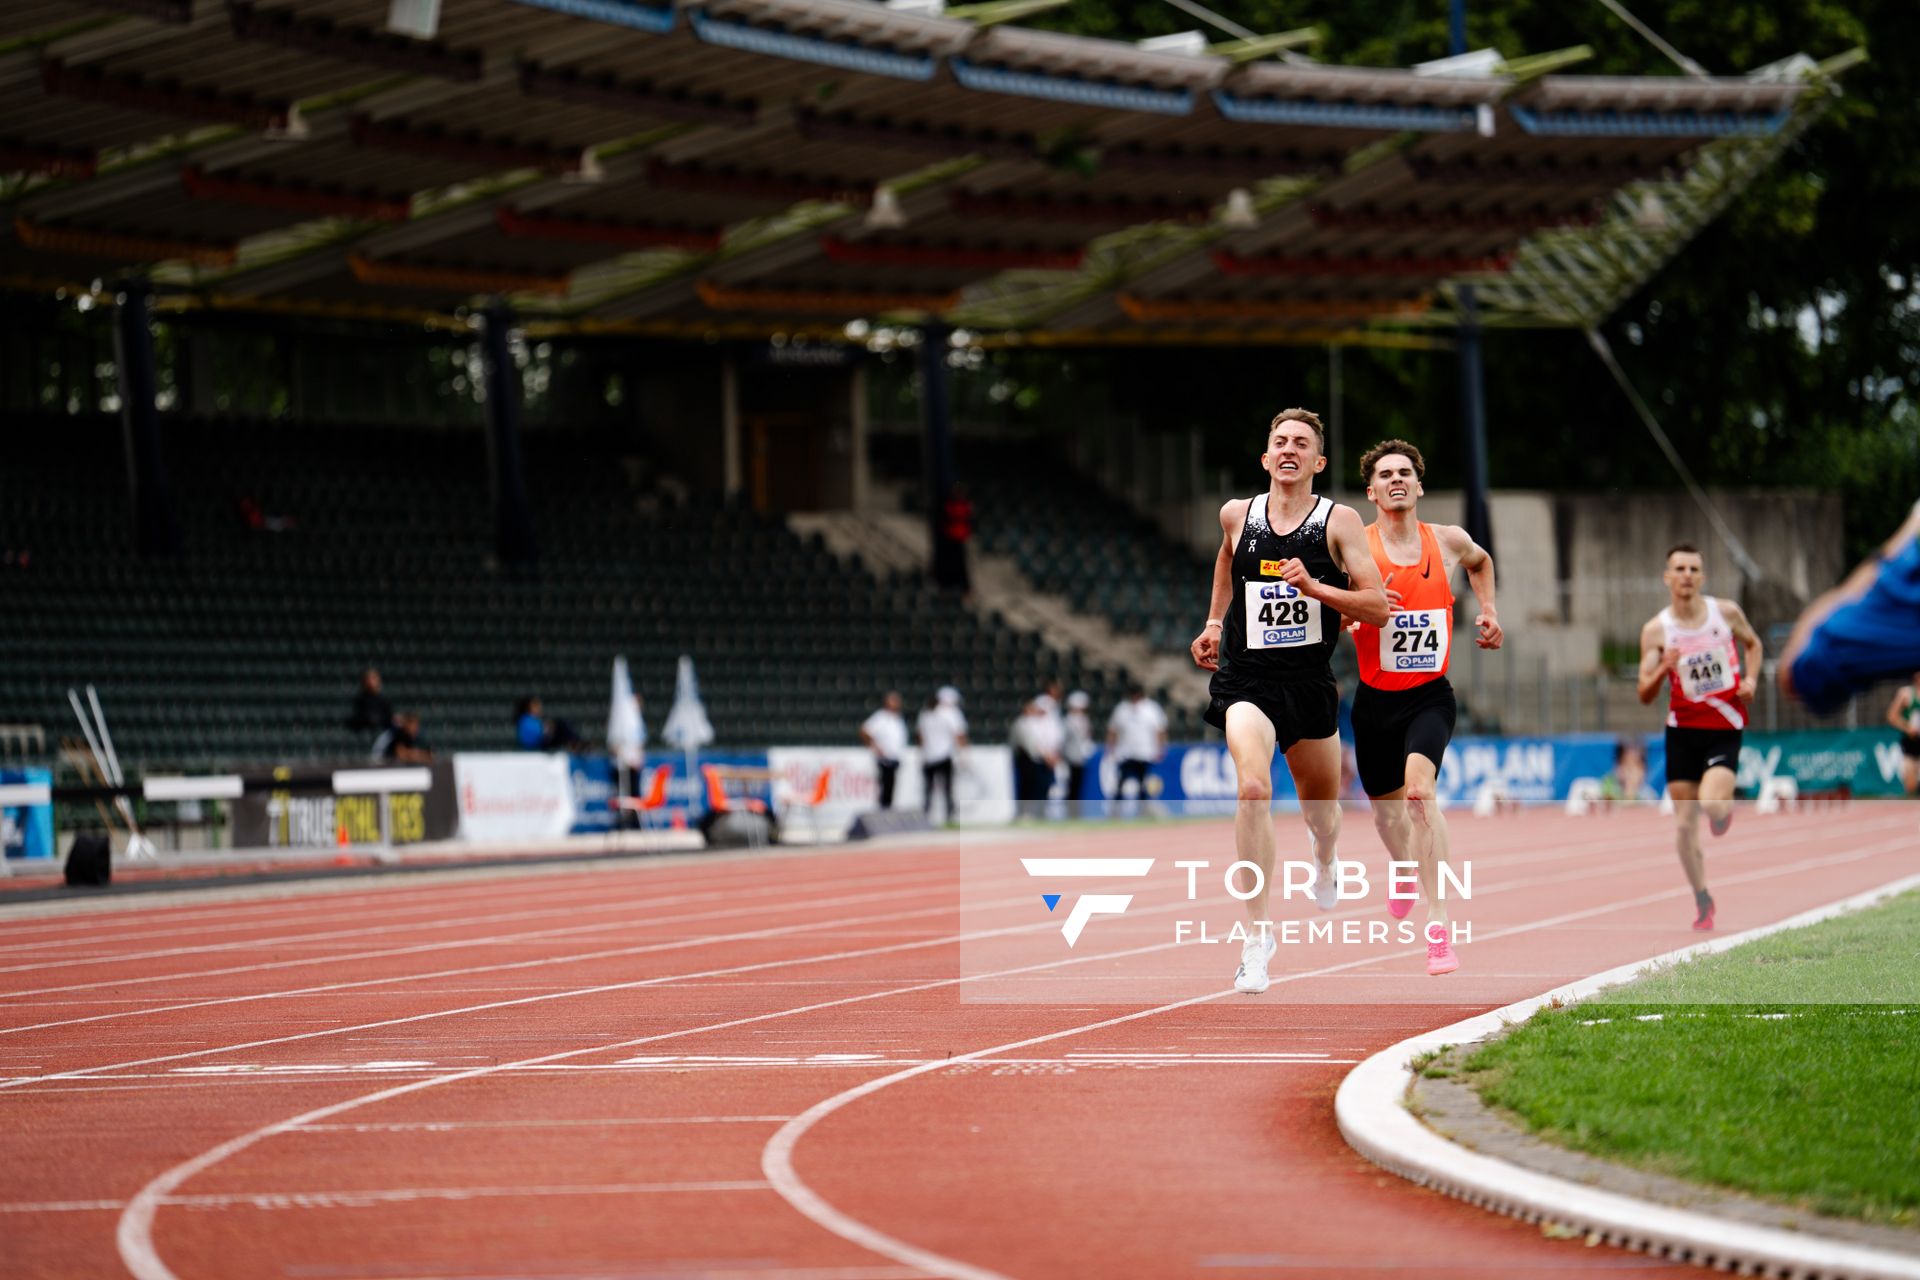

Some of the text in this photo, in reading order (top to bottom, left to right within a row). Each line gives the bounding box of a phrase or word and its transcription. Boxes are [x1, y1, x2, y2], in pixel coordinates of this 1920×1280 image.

[1260, 585, 1298, 600] GLS
[1258, 600, 1309, 626] 428
[1395, 614, 1430, 628] GLS
[1281, 629, 1304, 638] PLAN
[1392, 630, 1438, 652] 274
[1412, 656, 1435, 664] PLAN
[1690, 663, 1722, 680] 449
[1463, 743, 1554, 783] PLAN
